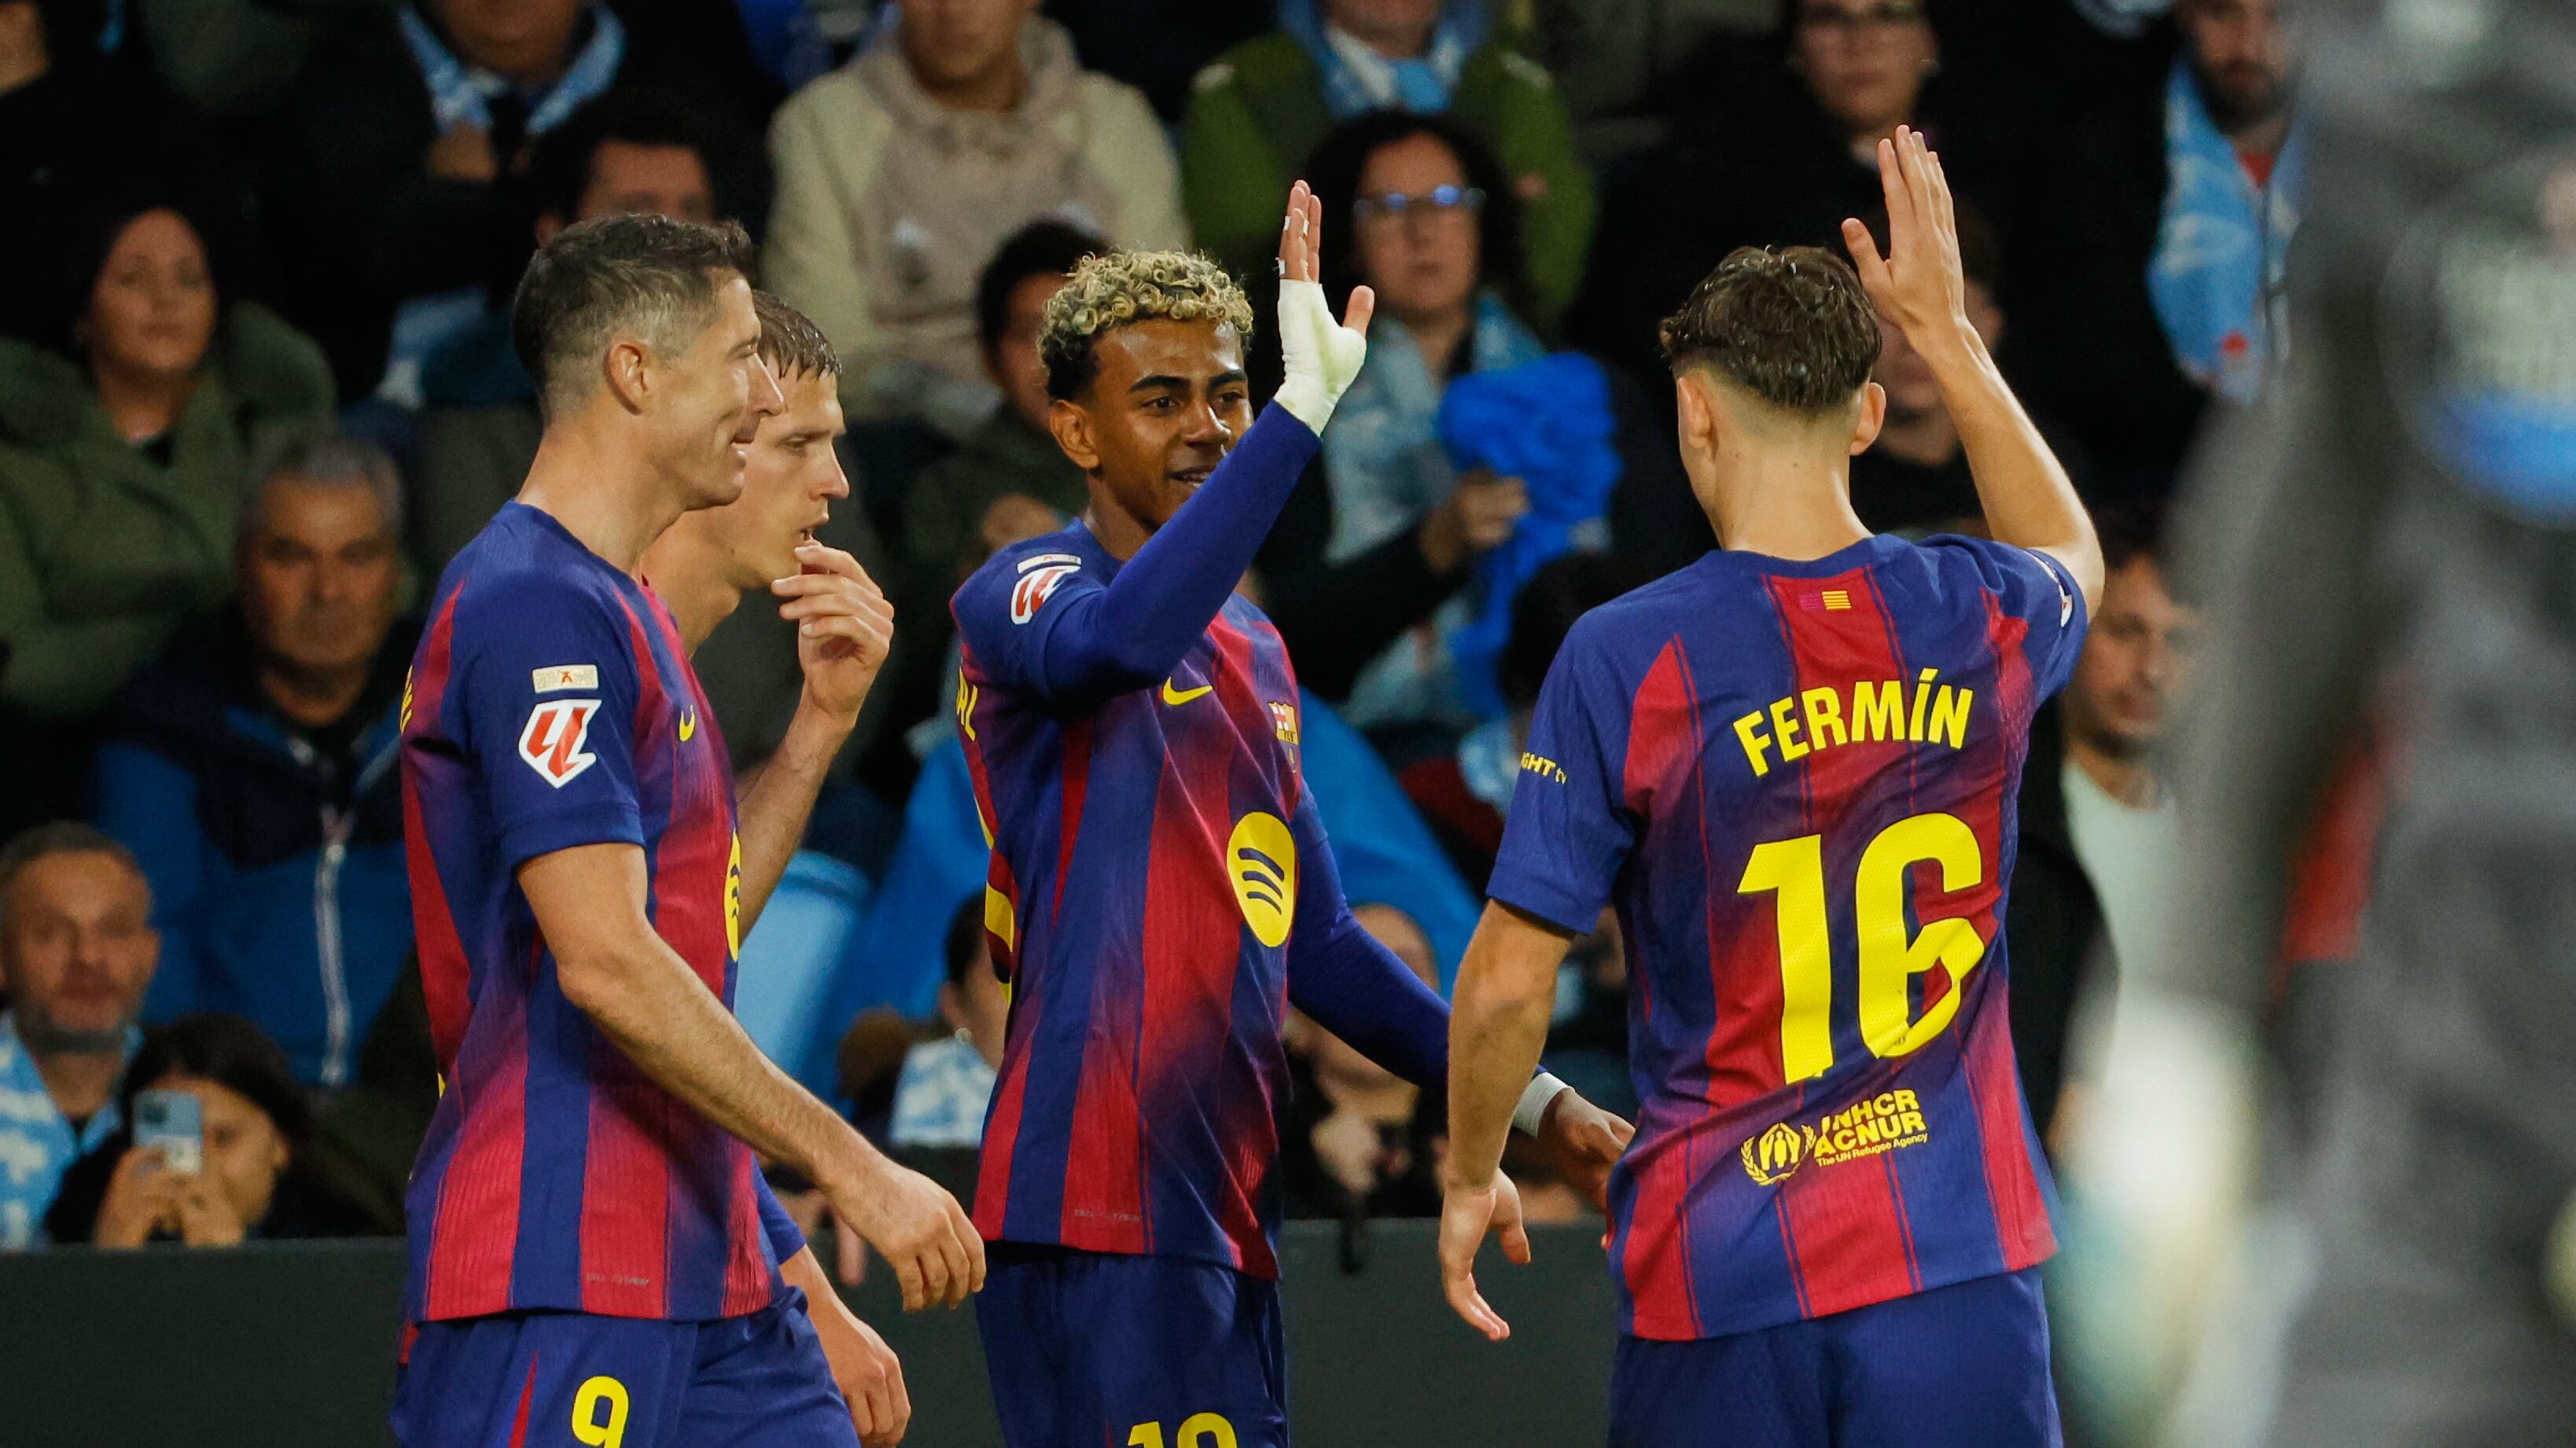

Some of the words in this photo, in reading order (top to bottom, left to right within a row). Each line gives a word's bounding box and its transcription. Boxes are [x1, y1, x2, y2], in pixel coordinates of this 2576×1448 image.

[1733, 667, 1974, 777] FERMÍN
[1737, 812, 1985, 1085] 16
[1813, 1112, 1926, 1159] ACNUR
[1816, 1157, 1835, 1167] The
[1835, 1152, 1852, 1162] UN
[1853, 1142, 1892, 1158] Refugee
[1893, 1134, 1927, 1147] Agency
[572, 1375, 630, 1448] 9
